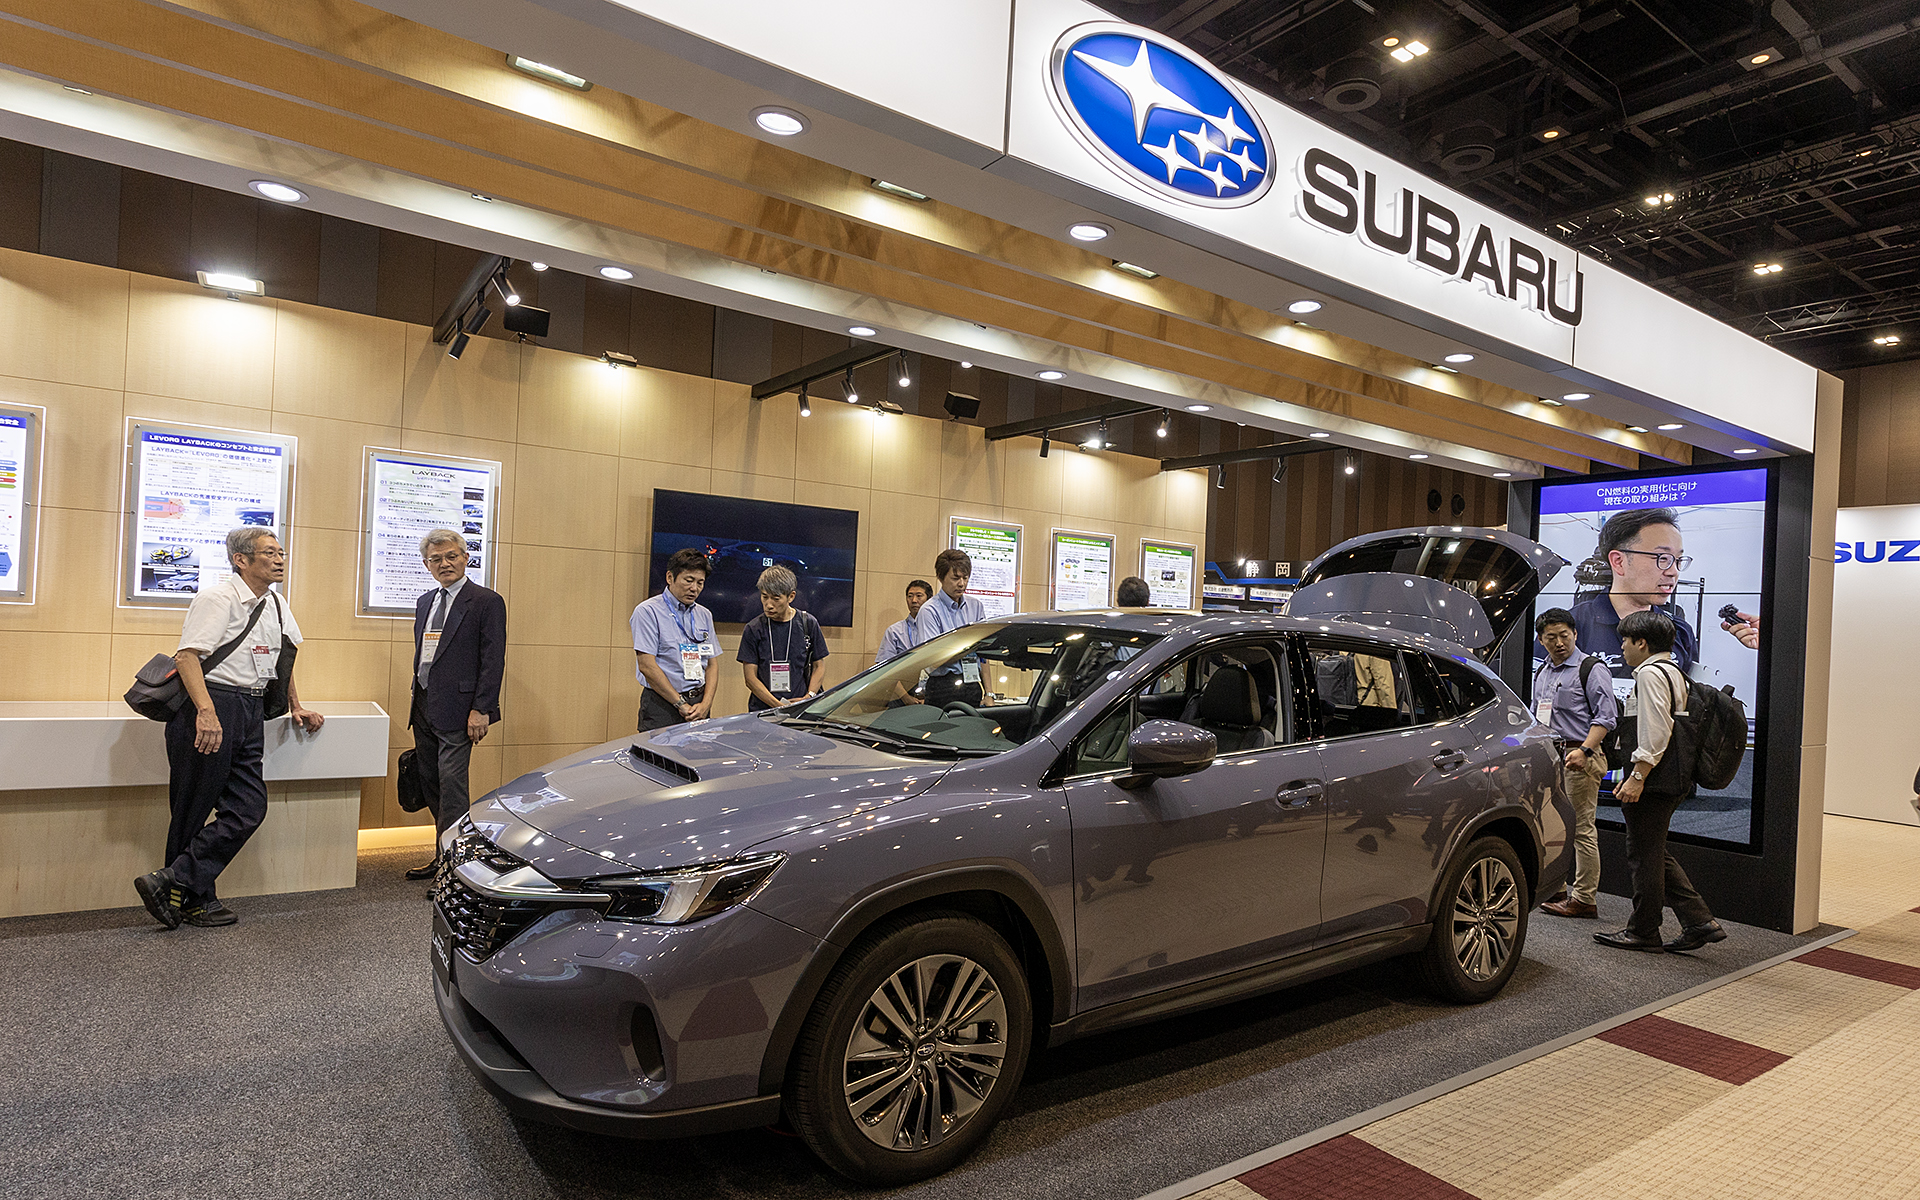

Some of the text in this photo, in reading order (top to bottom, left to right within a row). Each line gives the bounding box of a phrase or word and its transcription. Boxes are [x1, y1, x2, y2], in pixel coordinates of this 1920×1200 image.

[1301, 147, 1584, 327] SUBARU
[411, 469, 456, 479] LAYBACK
[1596, 481, 1698, 497] CN燃料の実用化に向け
[1603, 491, 1687, 506] 現在の取り組みは？
[1833, 540, 1920, 564] SUZ
